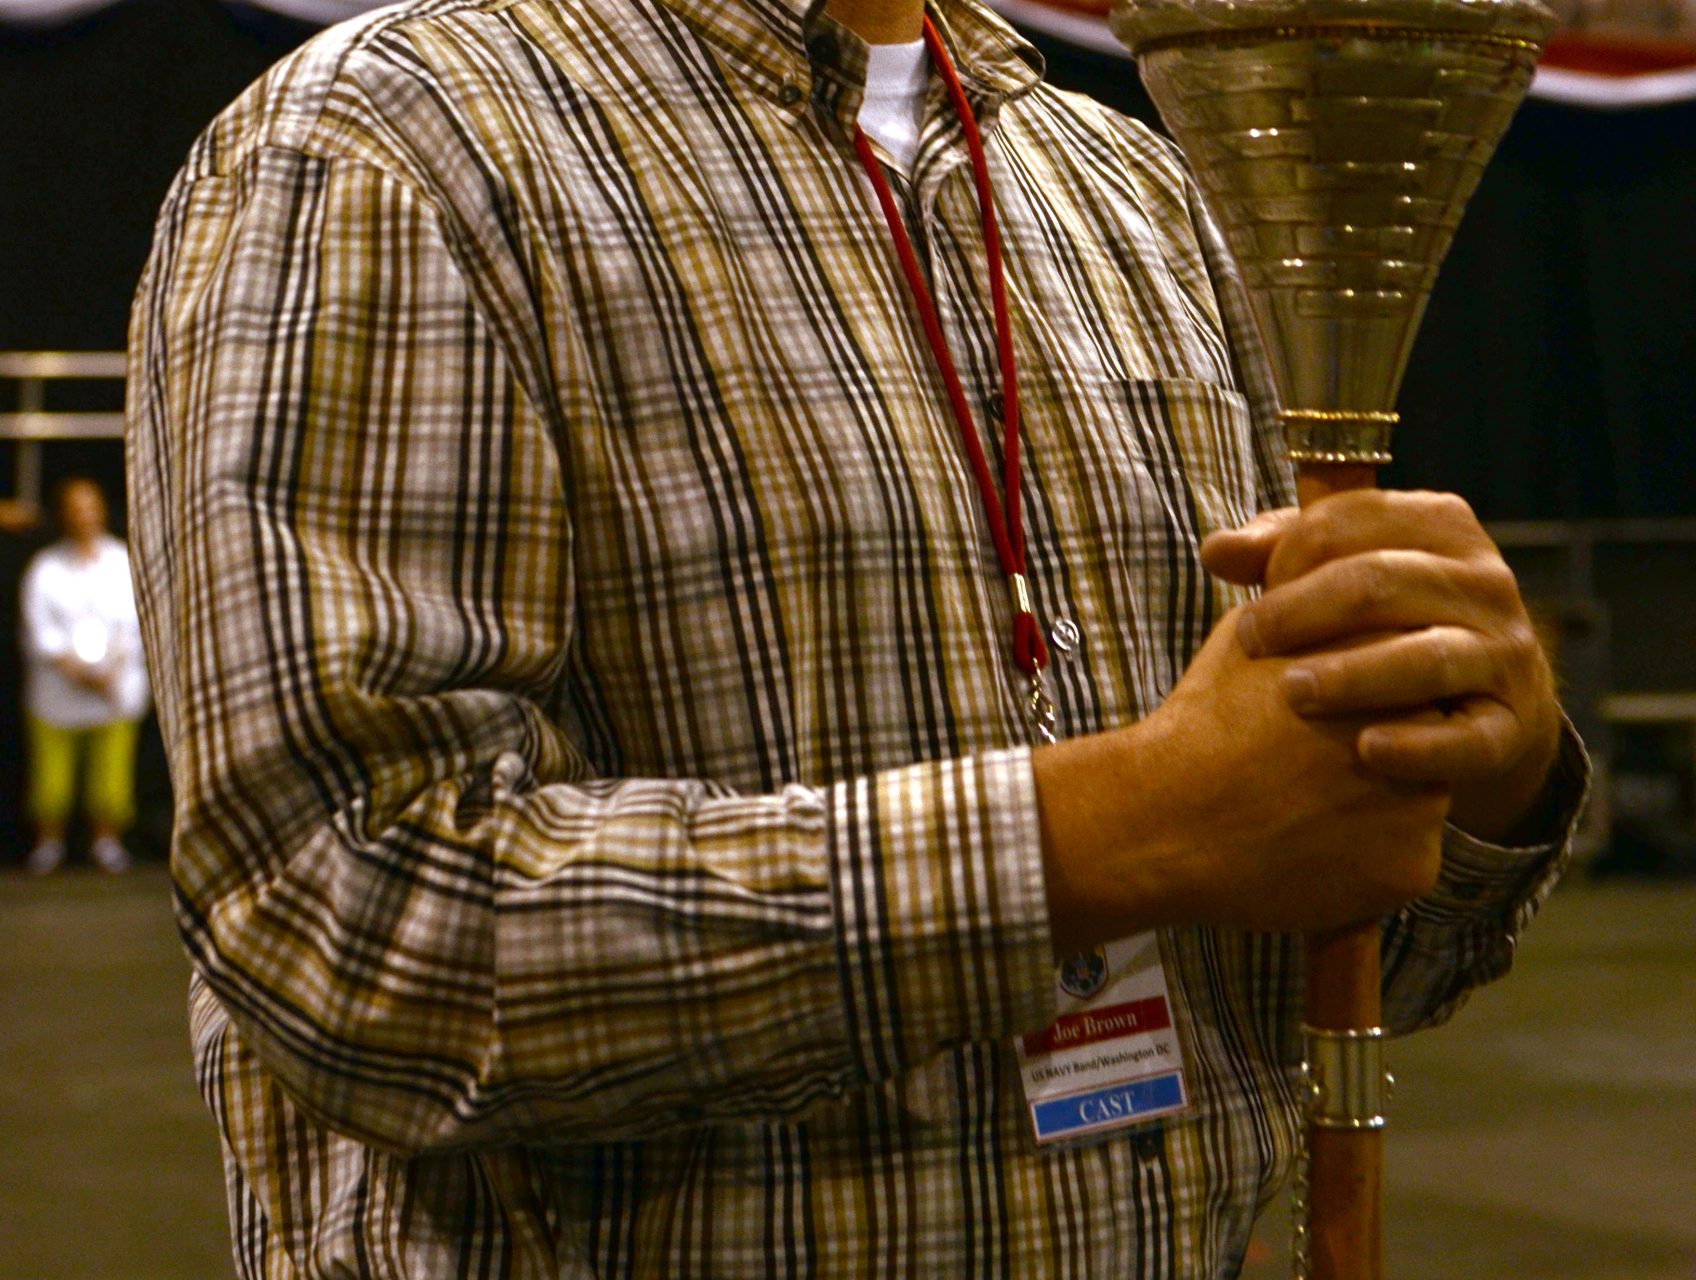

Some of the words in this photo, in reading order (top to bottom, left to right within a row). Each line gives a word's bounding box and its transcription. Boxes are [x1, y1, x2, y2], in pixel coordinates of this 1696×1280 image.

[1052, 1022, 1080, 1042] Joe
[1083, 1011, 1138, 1036] Brown
[1031, 1069, 1046, 1083] US
[1046, 1061, 1072, 1081] NAVY
[1156, 1042, 1170, 1057] DC
[1079, 1090, 1135, 1124] CAST
